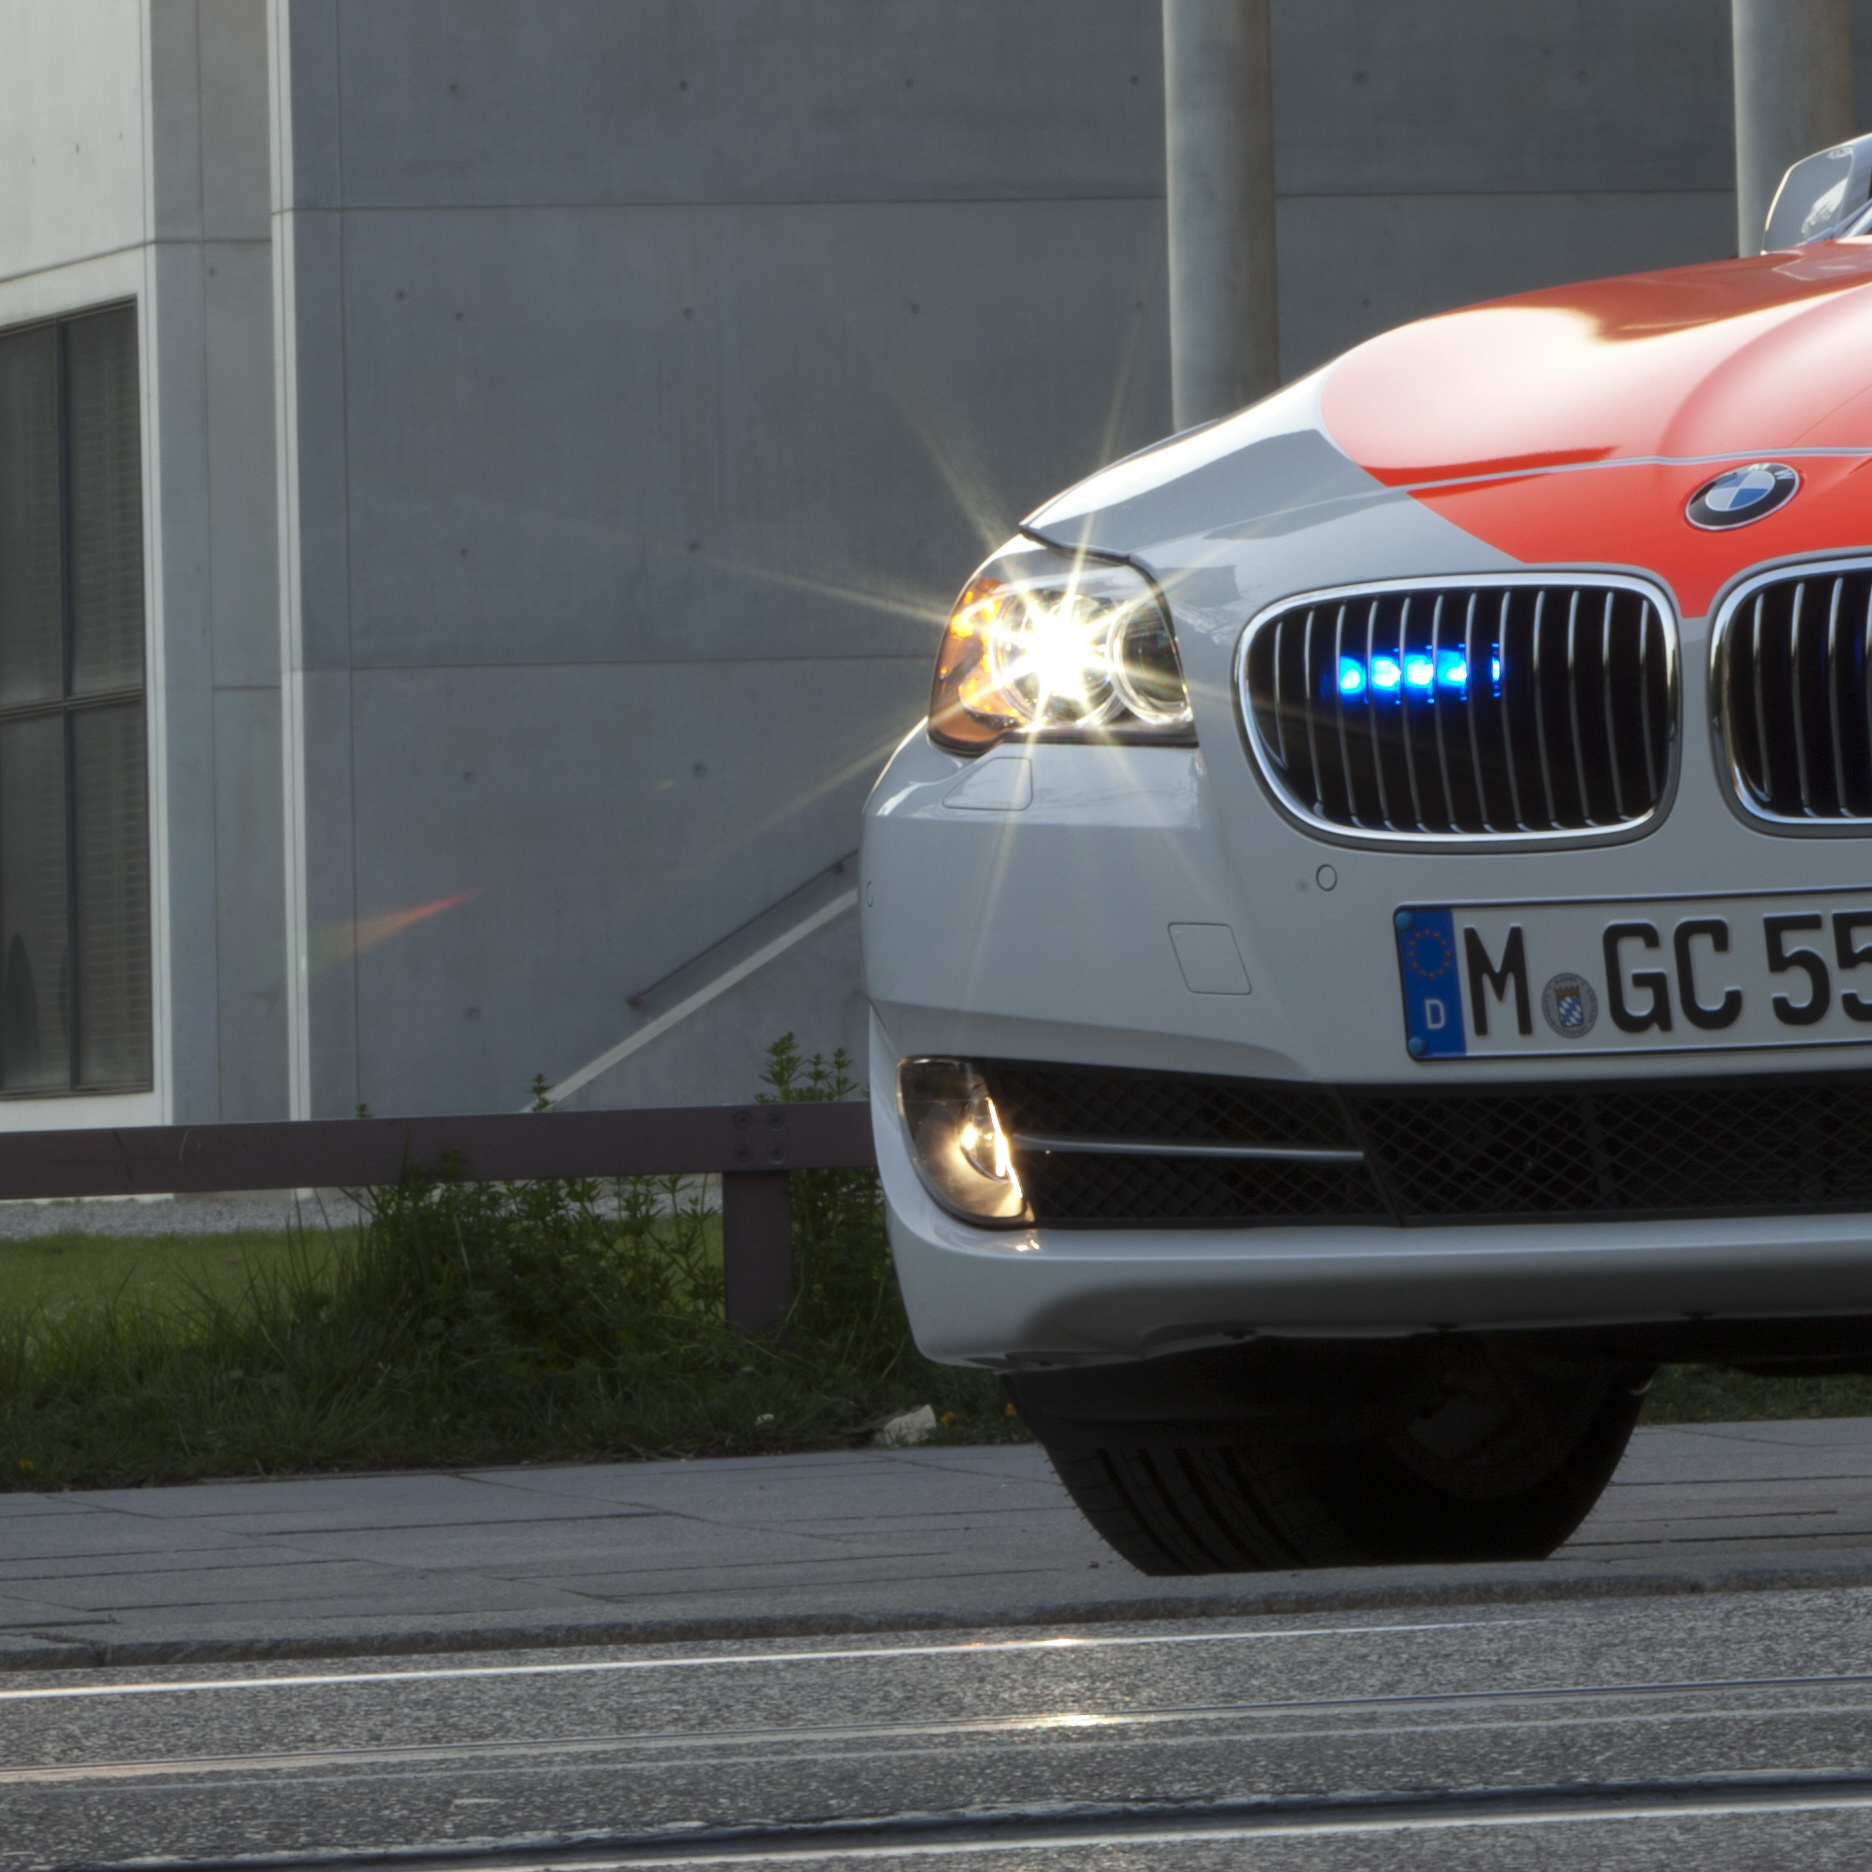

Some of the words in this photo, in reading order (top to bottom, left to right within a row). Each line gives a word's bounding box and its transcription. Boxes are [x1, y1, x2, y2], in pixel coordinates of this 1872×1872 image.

[1424, 998, 1446, 1030] D
[1463, 923, 1533, 1036] M
[1602, 918, 1743, 1033] GC
